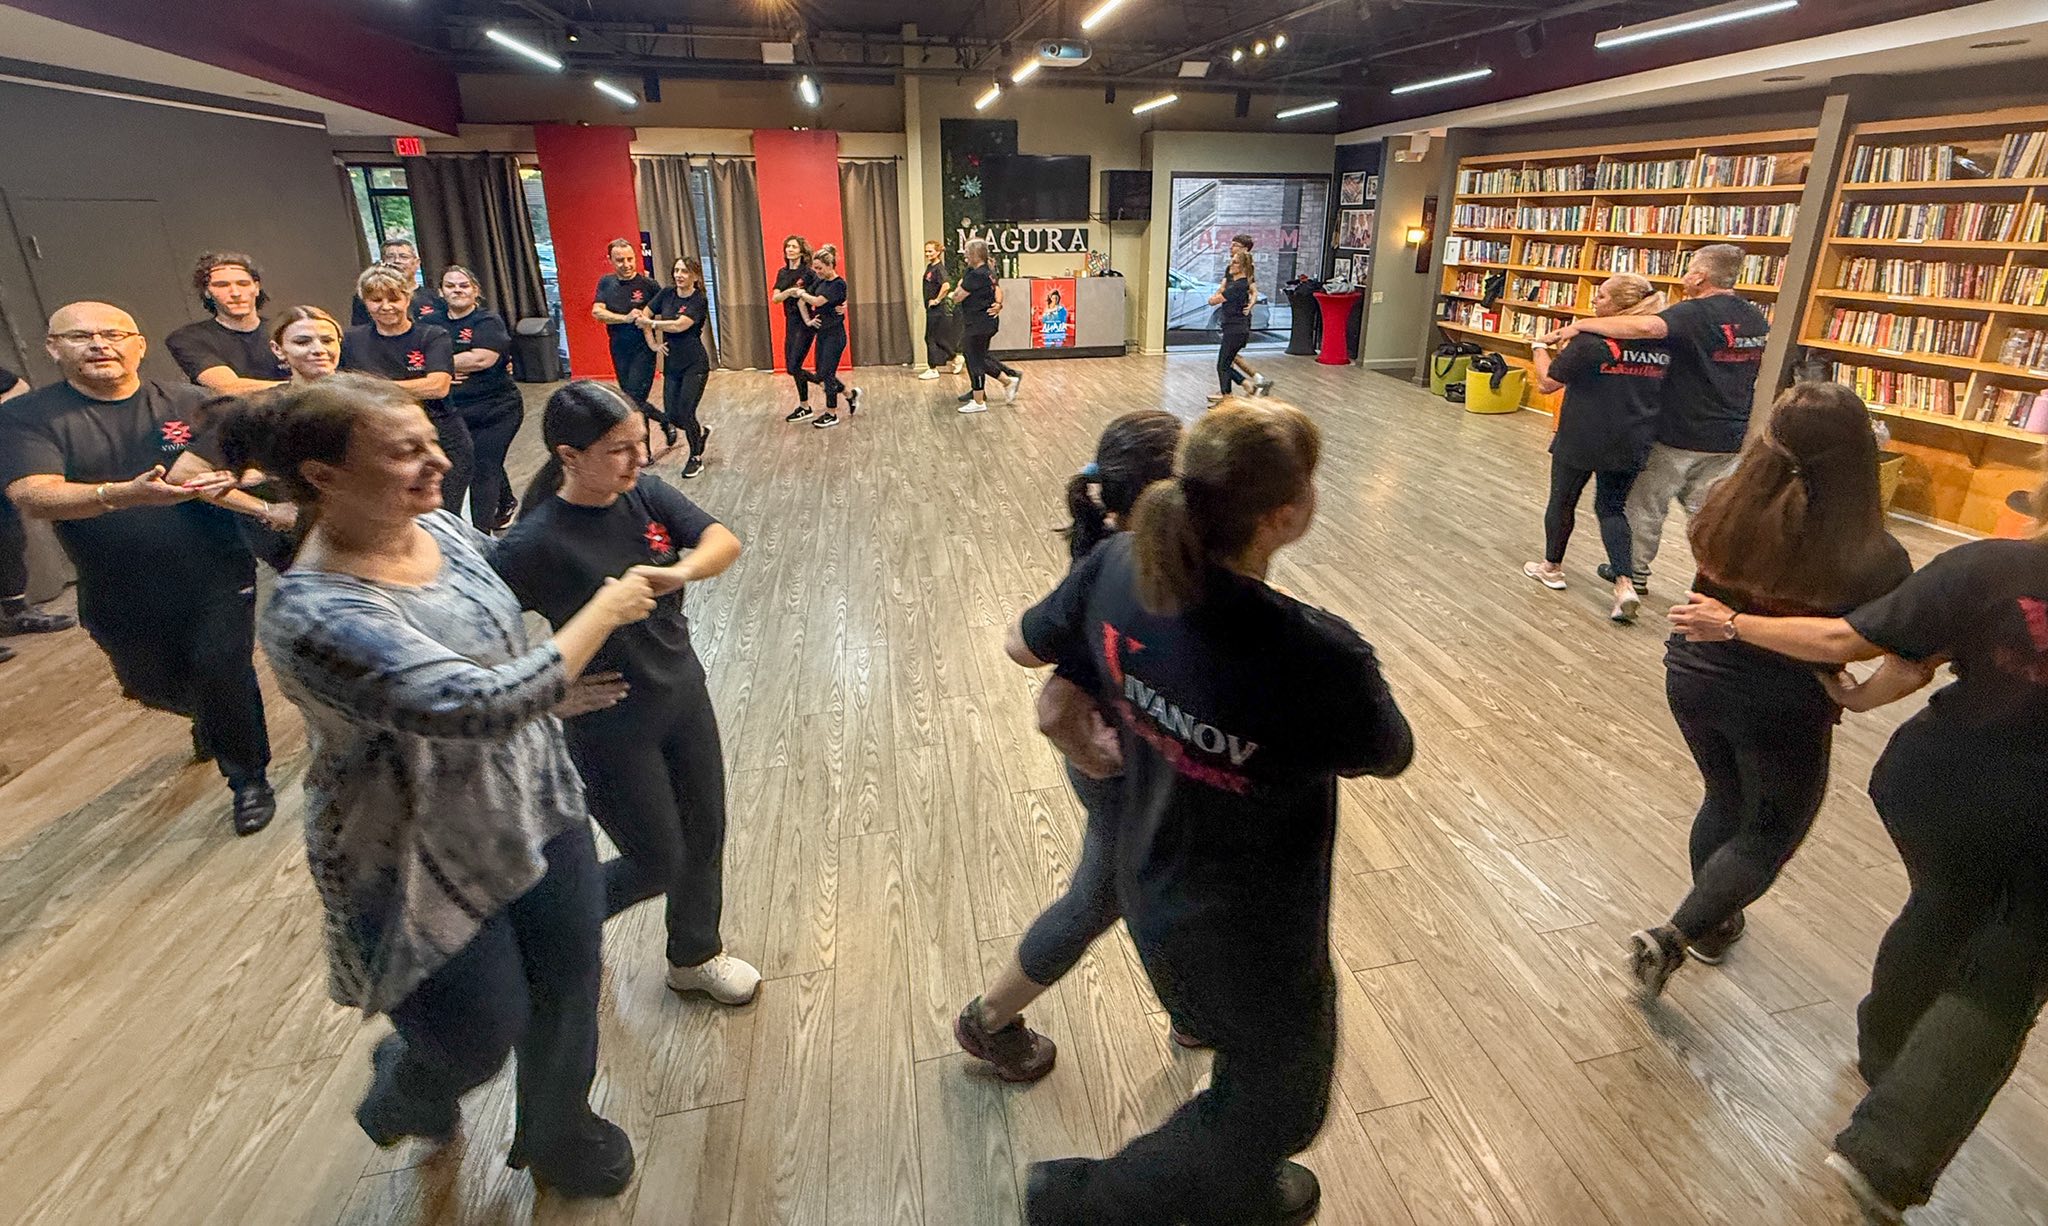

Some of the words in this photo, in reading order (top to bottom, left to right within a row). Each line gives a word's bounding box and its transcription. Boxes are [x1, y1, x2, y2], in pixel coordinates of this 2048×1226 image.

[396, 138, 420, 155] EXIT
[957, 228, 1087, 253] MAGURA
[1125, 673, 1259, 766] IVANOV
